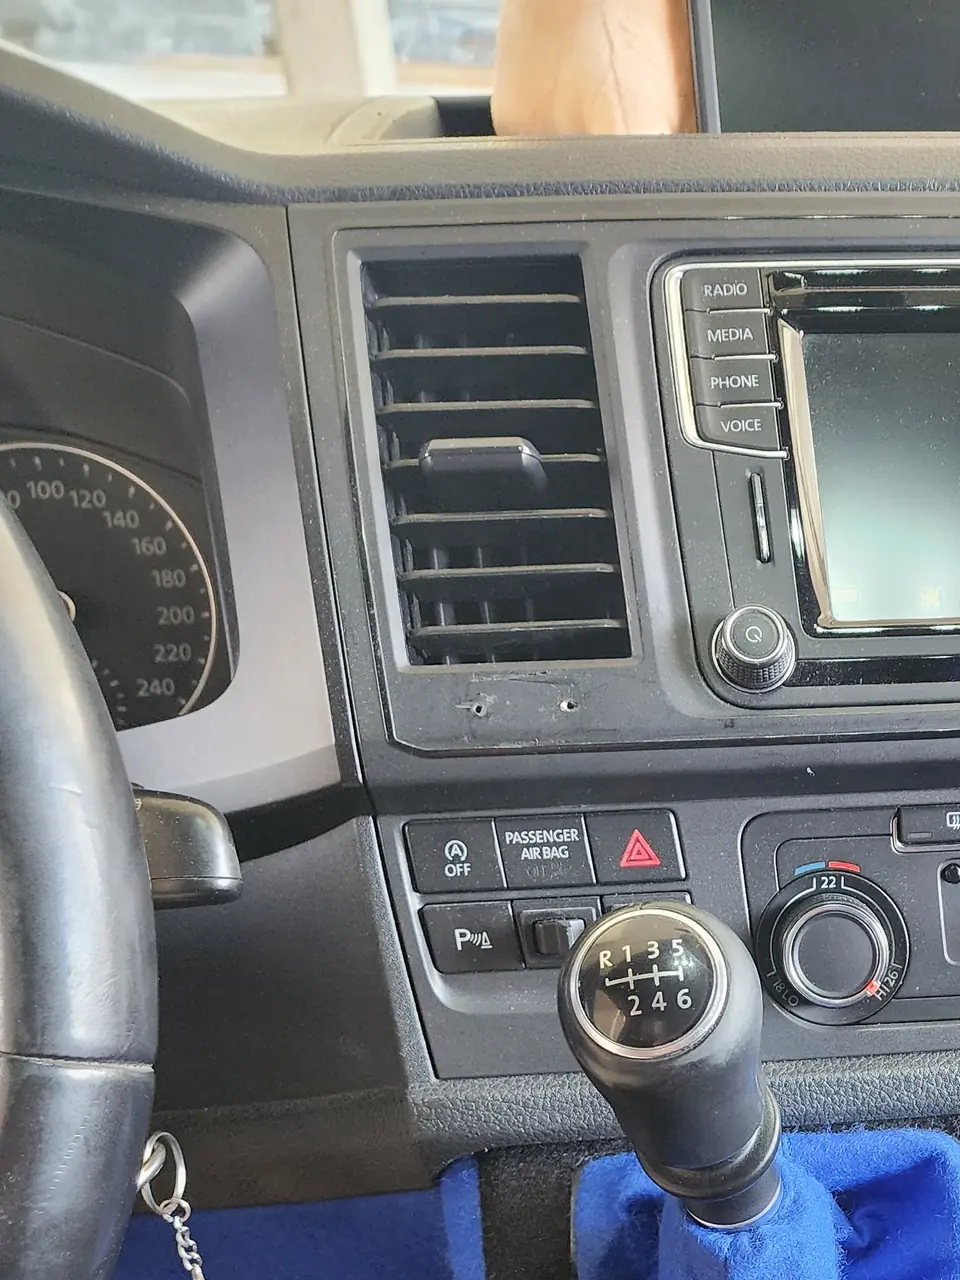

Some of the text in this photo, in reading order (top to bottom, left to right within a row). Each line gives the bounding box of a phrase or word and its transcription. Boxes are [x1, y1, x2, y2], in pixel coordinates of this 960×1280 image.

[703, 282, 748, 297] RADIO
[707, 327, 754, 343] MEDIA
[710, 374, 760, 389] PHONE
[720, 418, 762, 433] VOICE
[26, 480, 65, 500] 100
[69, 489, 107, 509] 120
[102, 510, 140, 529] 140
[131, 536, 167, 556] 160
[152, 569, 187, 588] 180
[157, 606, 195, 624] 200
[153, 644, 192, 663] 220
[136, 678, 175, 697] 240
[505, 828, 580, 844] PASSENGER
[444, 862, 472, 878] OFF
[820, 875, 837, 889] 22
[599, 938, 684, 970] R 1 3 5
[627, 988, 693, 1017] 2 4 6
